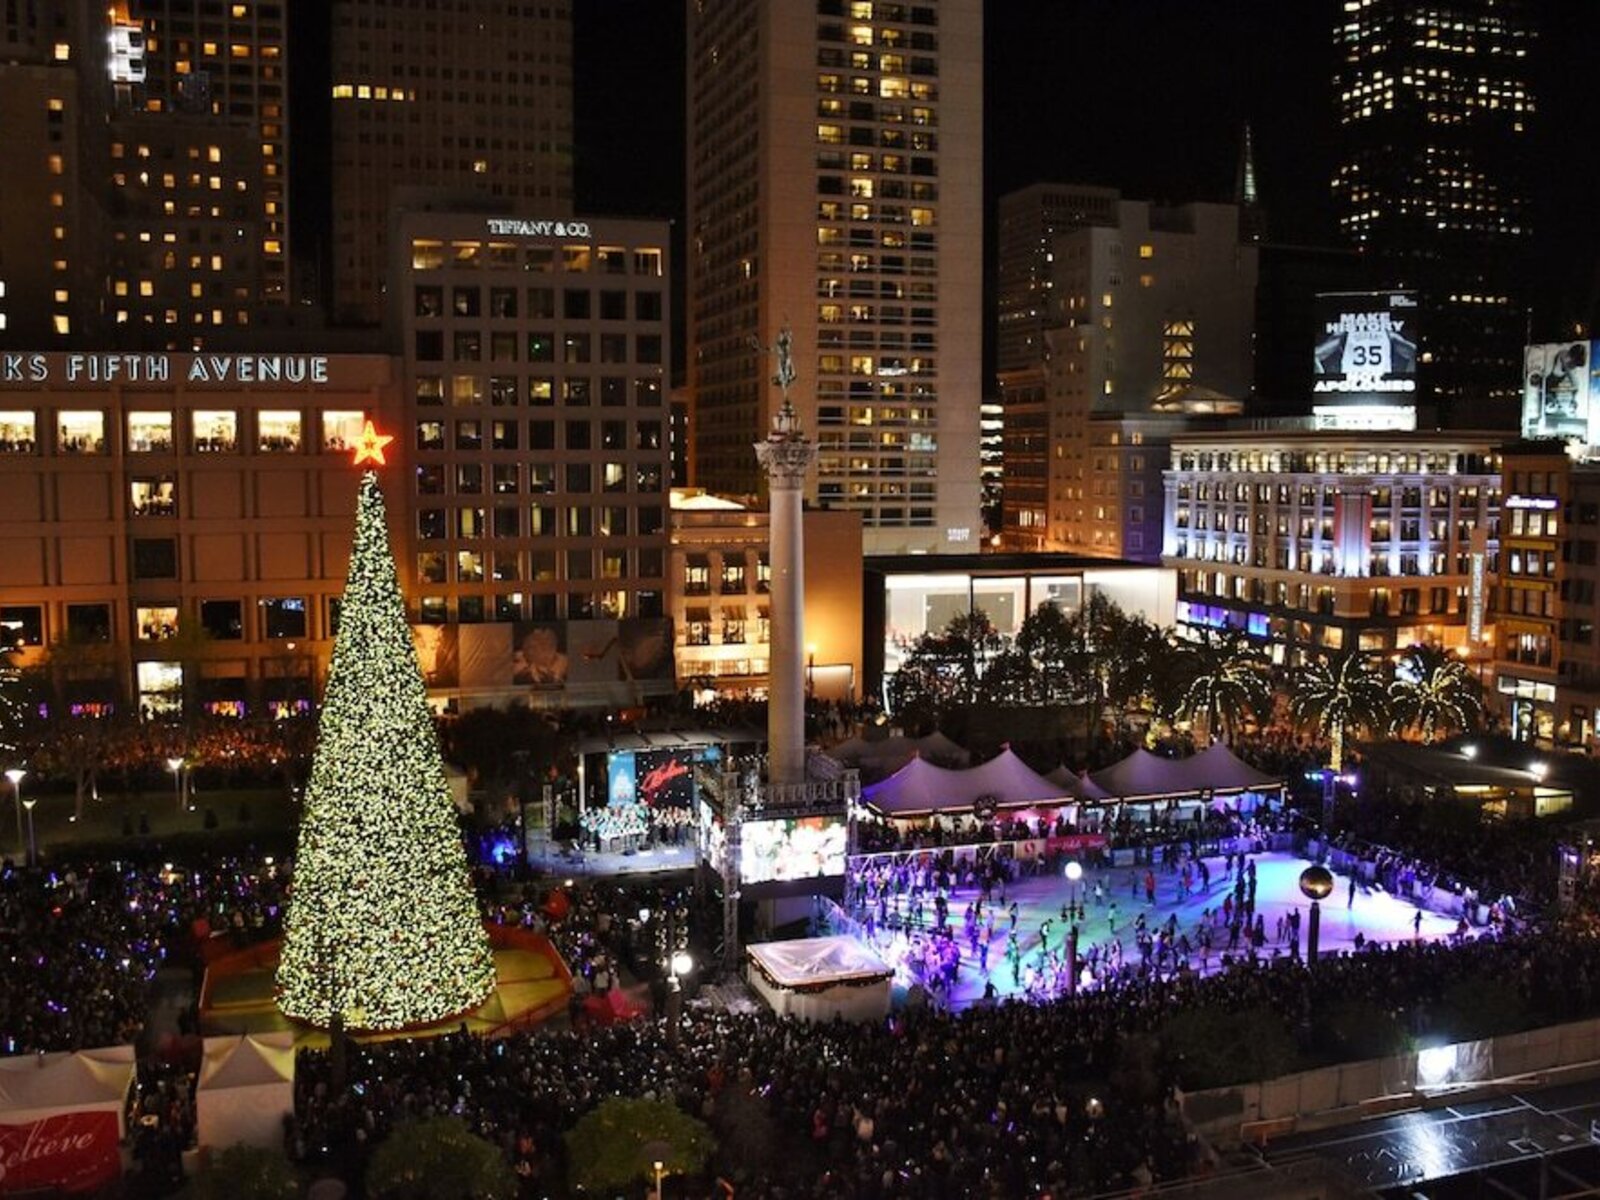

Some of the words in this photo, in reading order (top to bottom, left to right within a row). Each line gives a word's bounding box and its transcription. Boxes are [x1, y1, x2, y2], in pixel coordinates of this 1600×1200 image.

[487, 219, 553, 235] TIFFANY
[555, 222, 567, 236] &
[1341, 312, 1390, 323] MAKE
[1326, 321, 1404, 334] HISTORY
[1353, 345, 1382, 366] 35
[5, 355, 48, 381] KS
[67, 355, 168, 382] FIFTH
[188, 356, 328, 382] AVENUE
[0, 1119, 94, 1171] elieve
